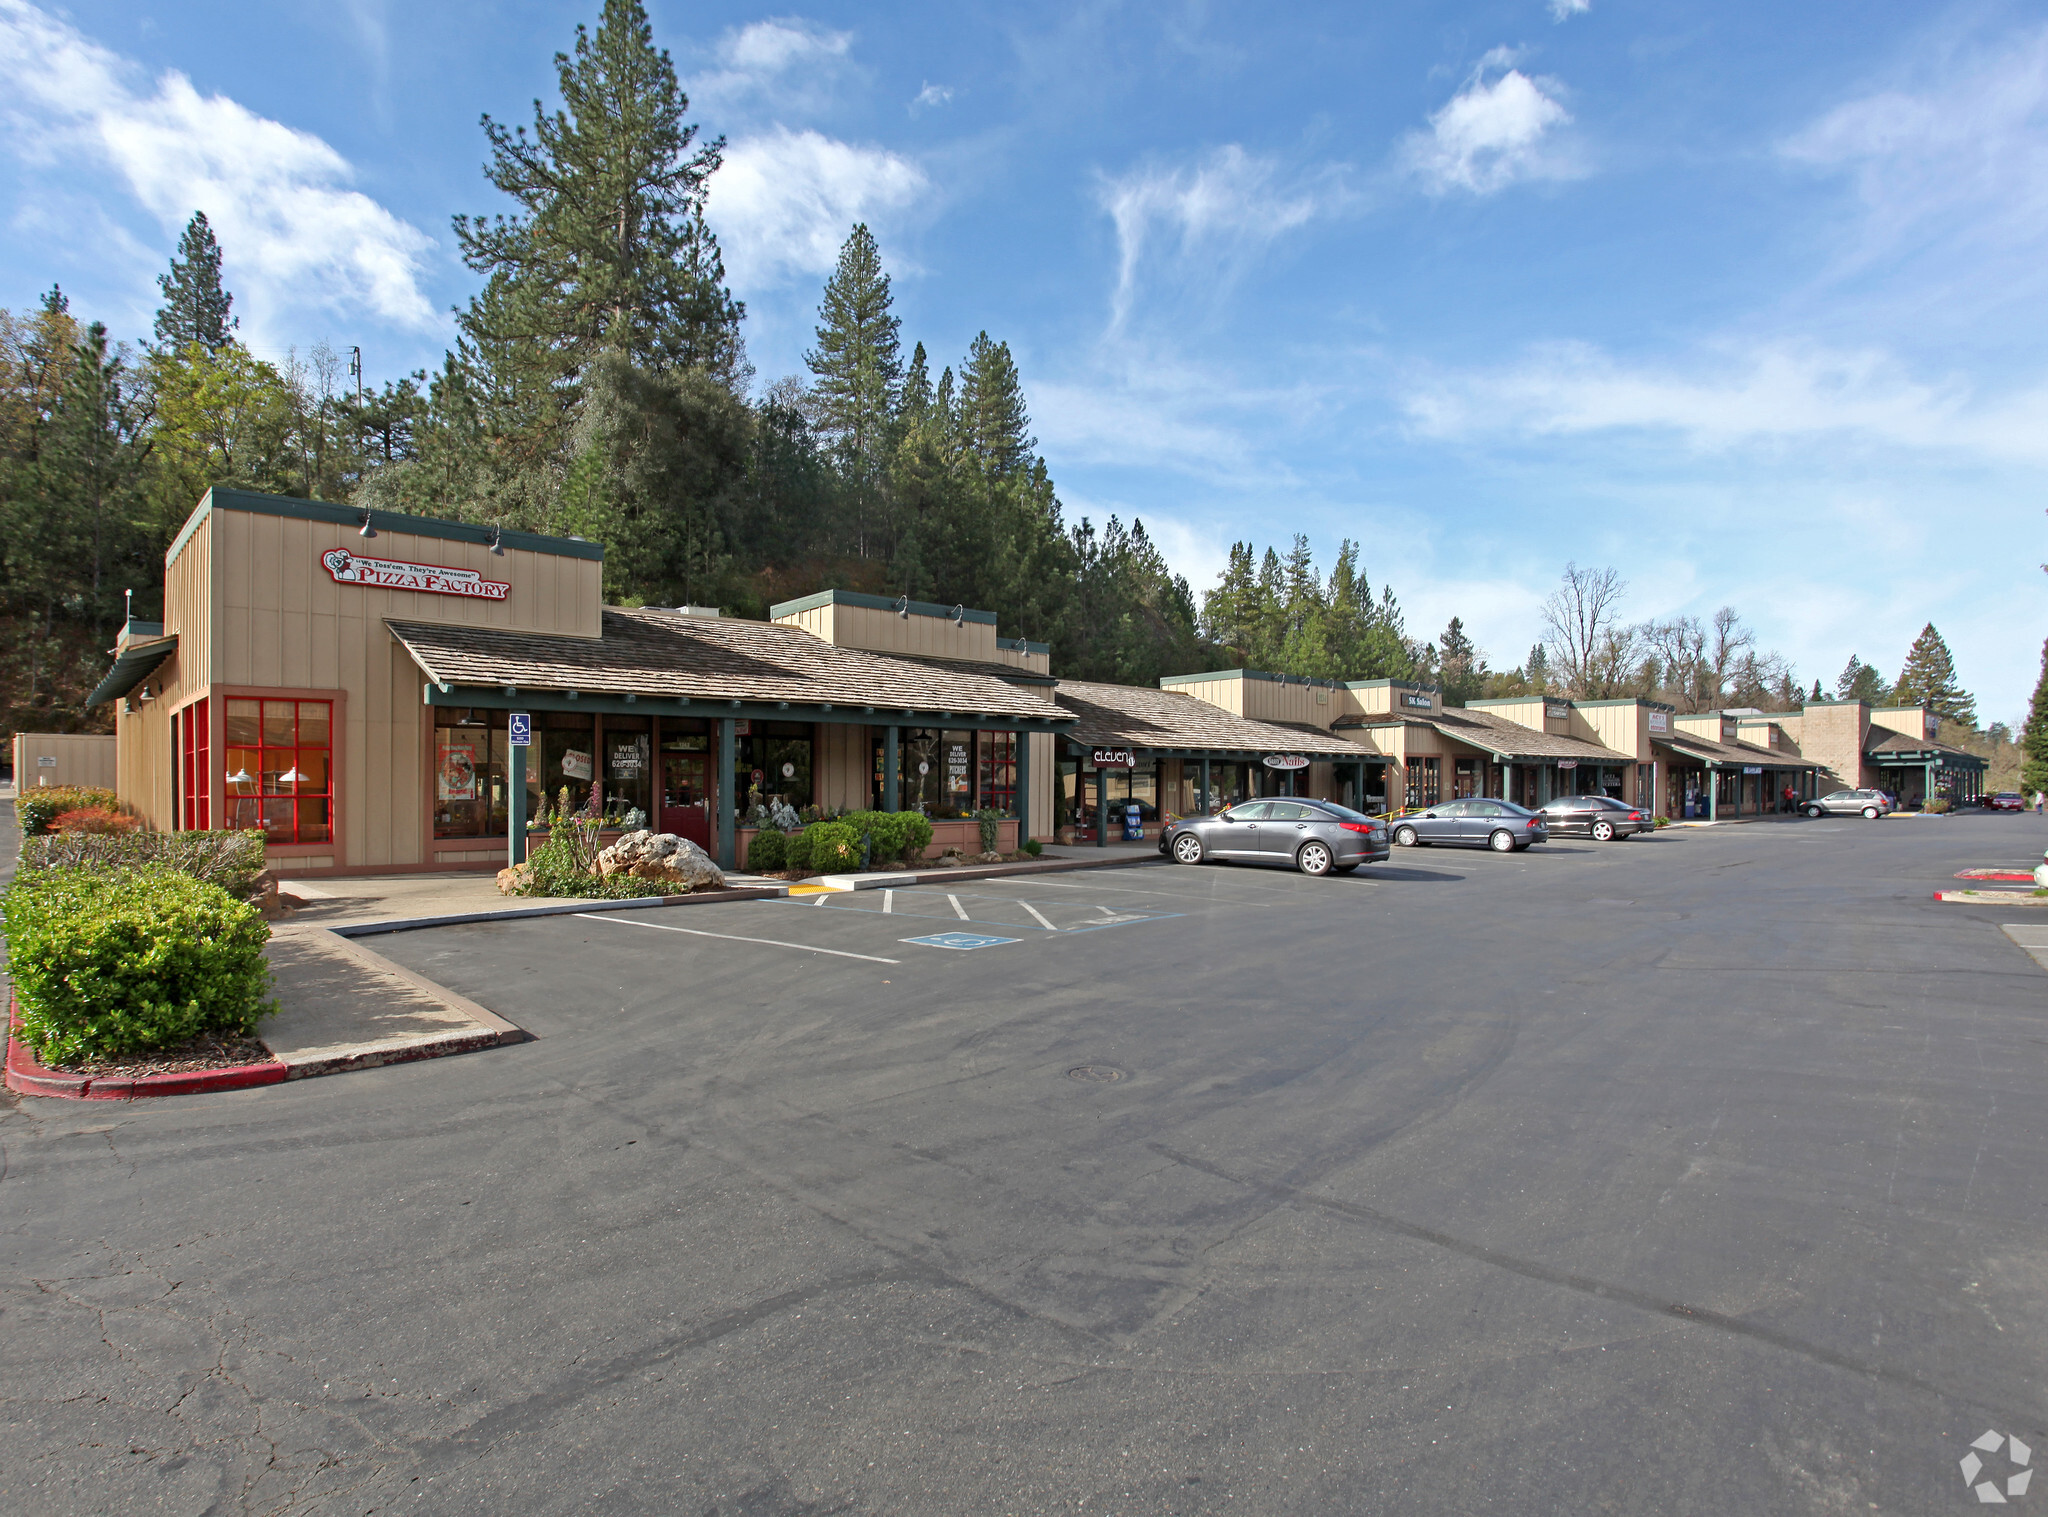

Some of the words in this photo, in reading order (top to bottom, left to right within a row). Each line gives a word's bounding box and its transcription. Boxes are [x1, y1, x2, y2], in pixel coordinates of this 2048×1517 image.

[408, 565, 436, 575] They're
[356, 566, 420, 588] PIZZA
[421, 574, 508, 597] FACTORY
[1416, 697, 1431, 707] Salon
[618, 745, 635, 753] WE
[614, 752, 640, 760] DELIVER
[1282, 755, 1305, 767] Nails
